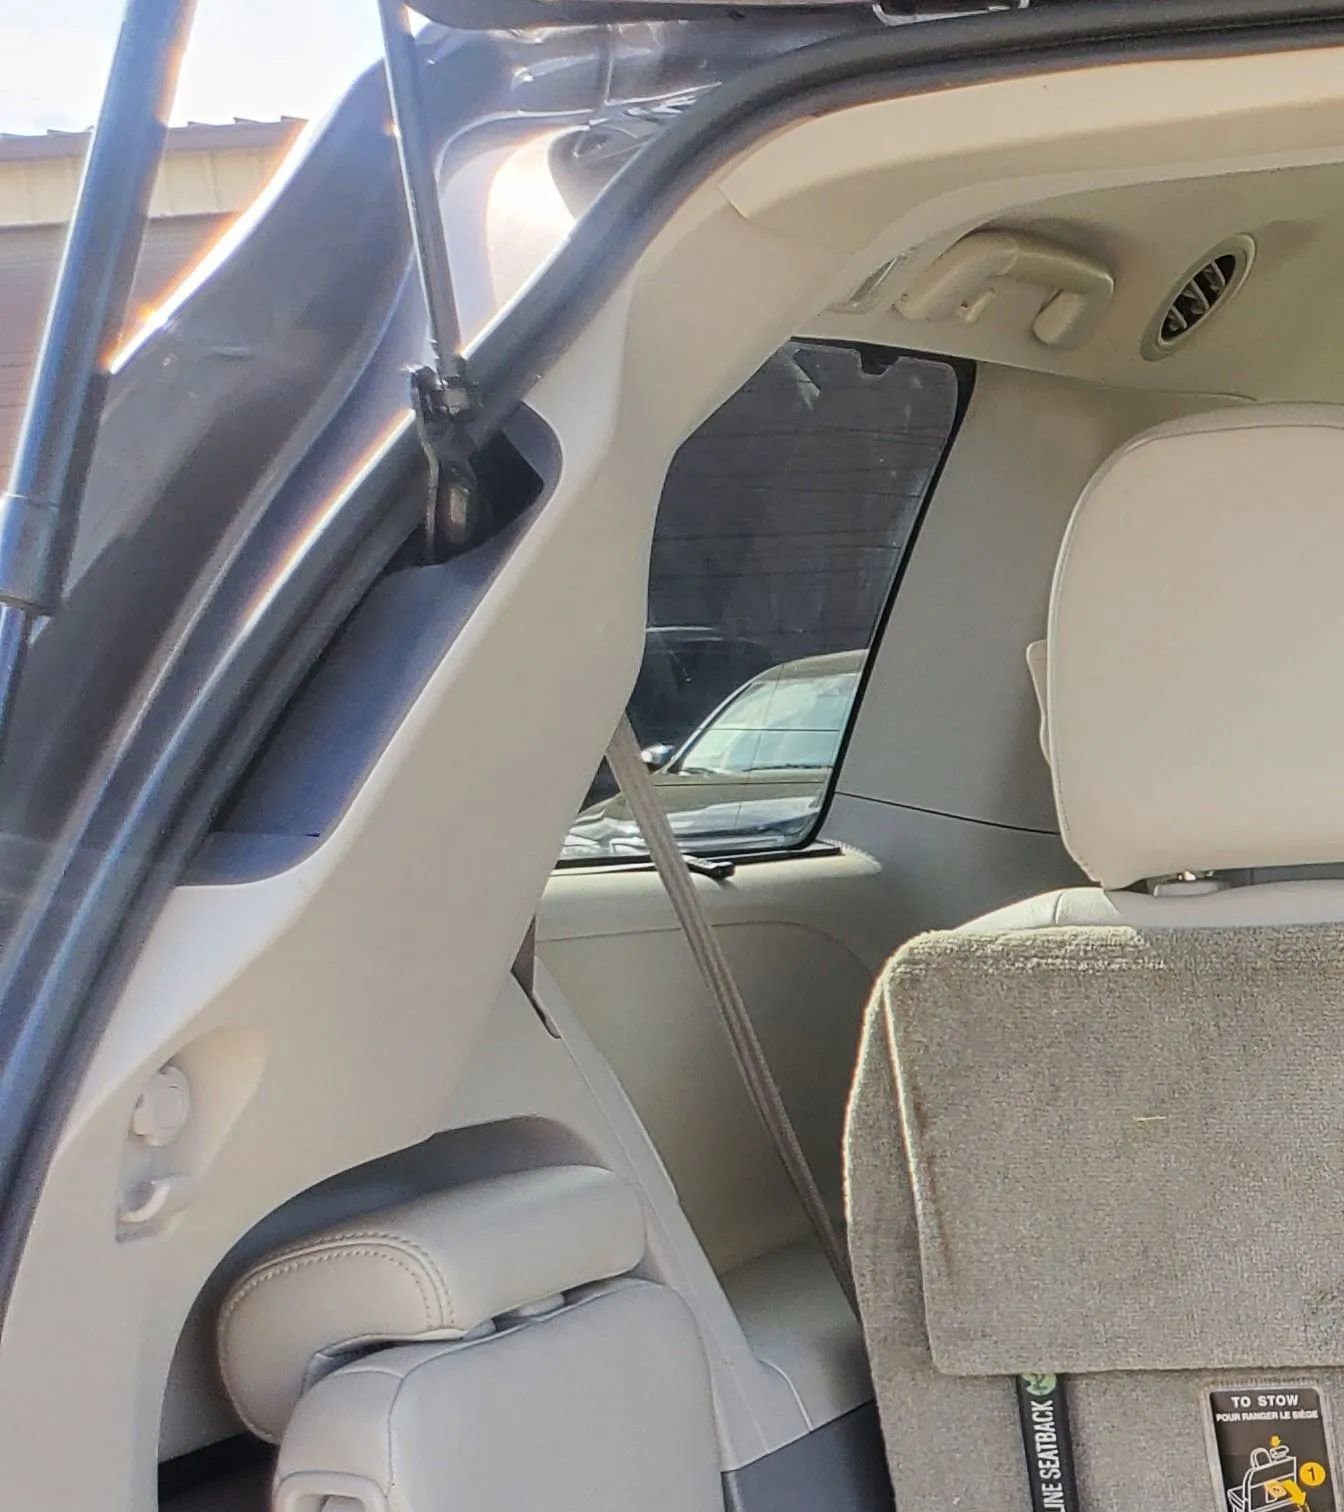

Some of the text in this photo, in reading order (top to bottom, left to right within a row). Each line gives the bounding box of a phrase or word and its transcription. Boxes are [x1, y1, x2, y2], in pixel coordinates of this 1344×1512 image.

[1231, 1395, 1298, 1408] TO STOW
[1216, 1413, 1241, 1422] POUR
[1031, 1400, 1061, 1479] SEATBACK
